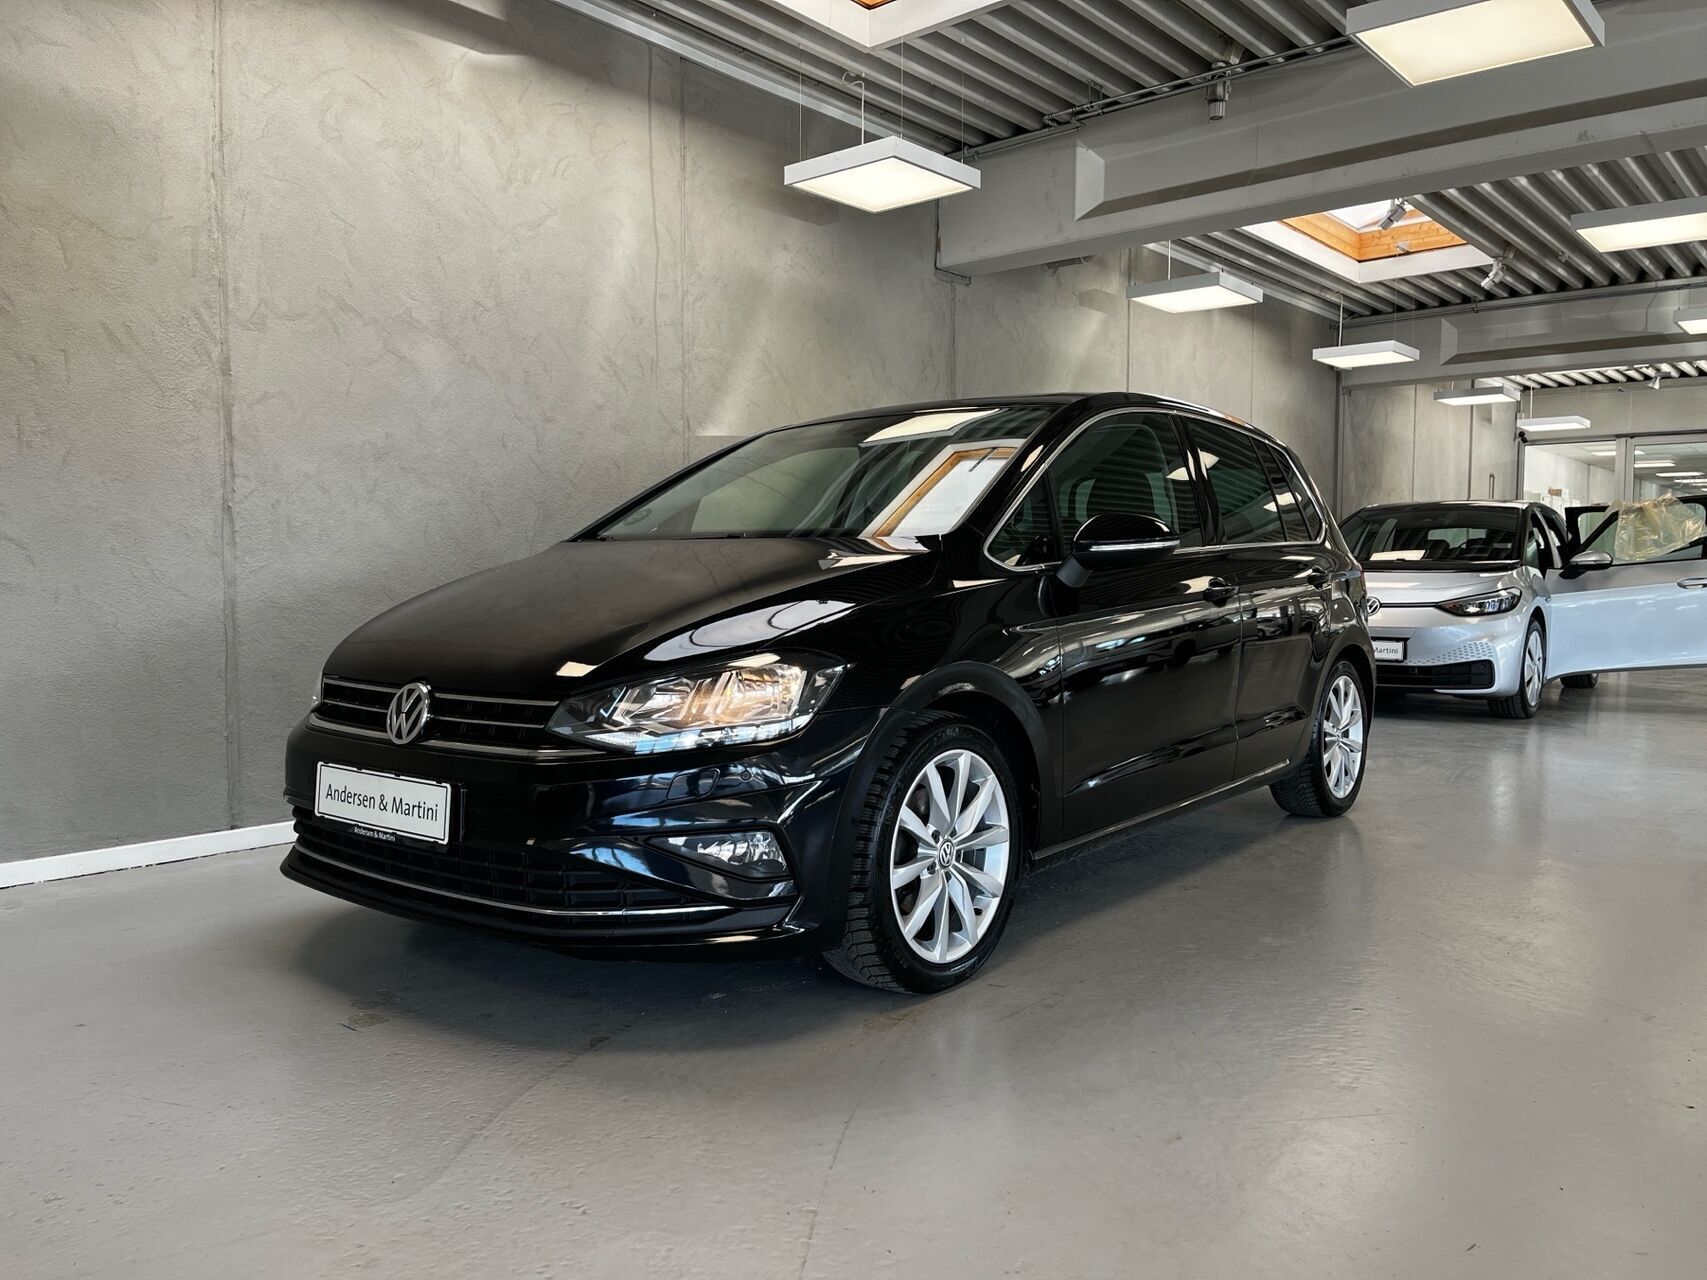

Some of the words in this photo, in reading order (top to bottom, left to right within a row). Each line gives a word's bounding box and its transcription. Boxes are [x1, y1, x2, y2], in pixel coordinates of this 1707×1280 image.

[326, 784, 376, 809] Andersen
[378, 794, 388, 812] &
[391, 796, 439, 822] Martini
[354, 826, 374, 837] Andersen
[379, 832, 396, 842] Martini
